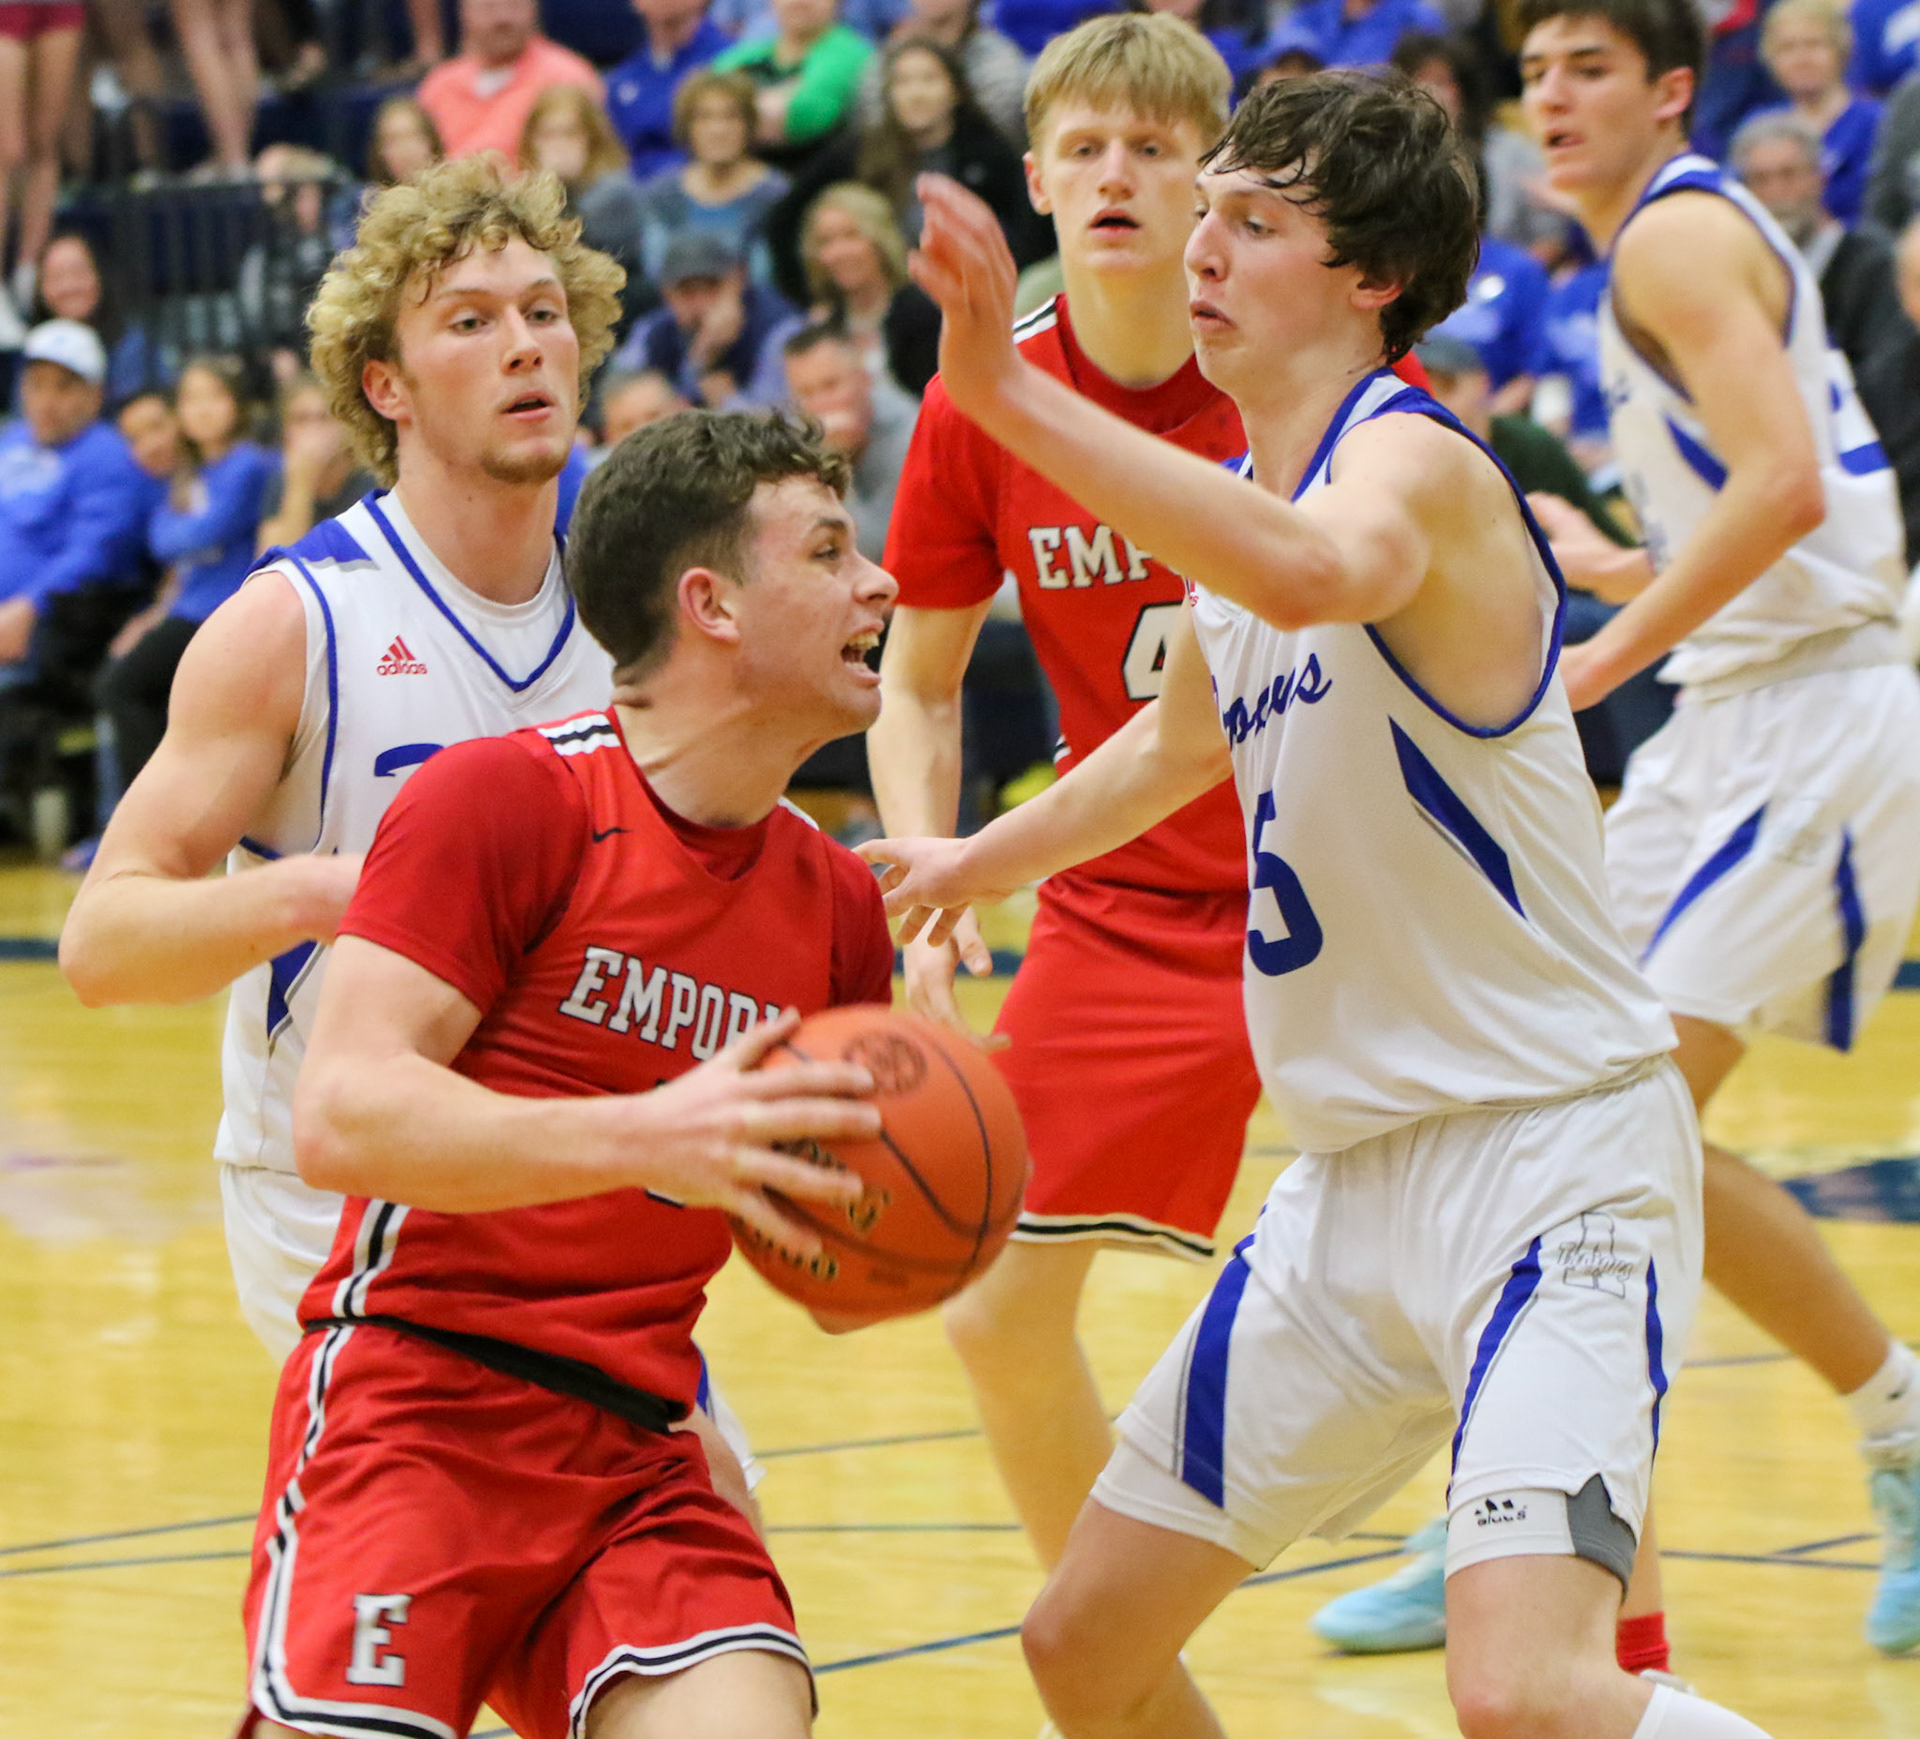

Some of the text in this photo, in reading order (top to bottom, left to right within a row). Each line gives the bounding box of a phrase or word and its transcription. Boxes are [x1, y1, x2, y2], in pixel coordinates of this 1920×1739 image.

[376, 657, 428, 676] adidas
[1248, 788, 1324, 977] 5
[345, 1592, 413, 1689] E
